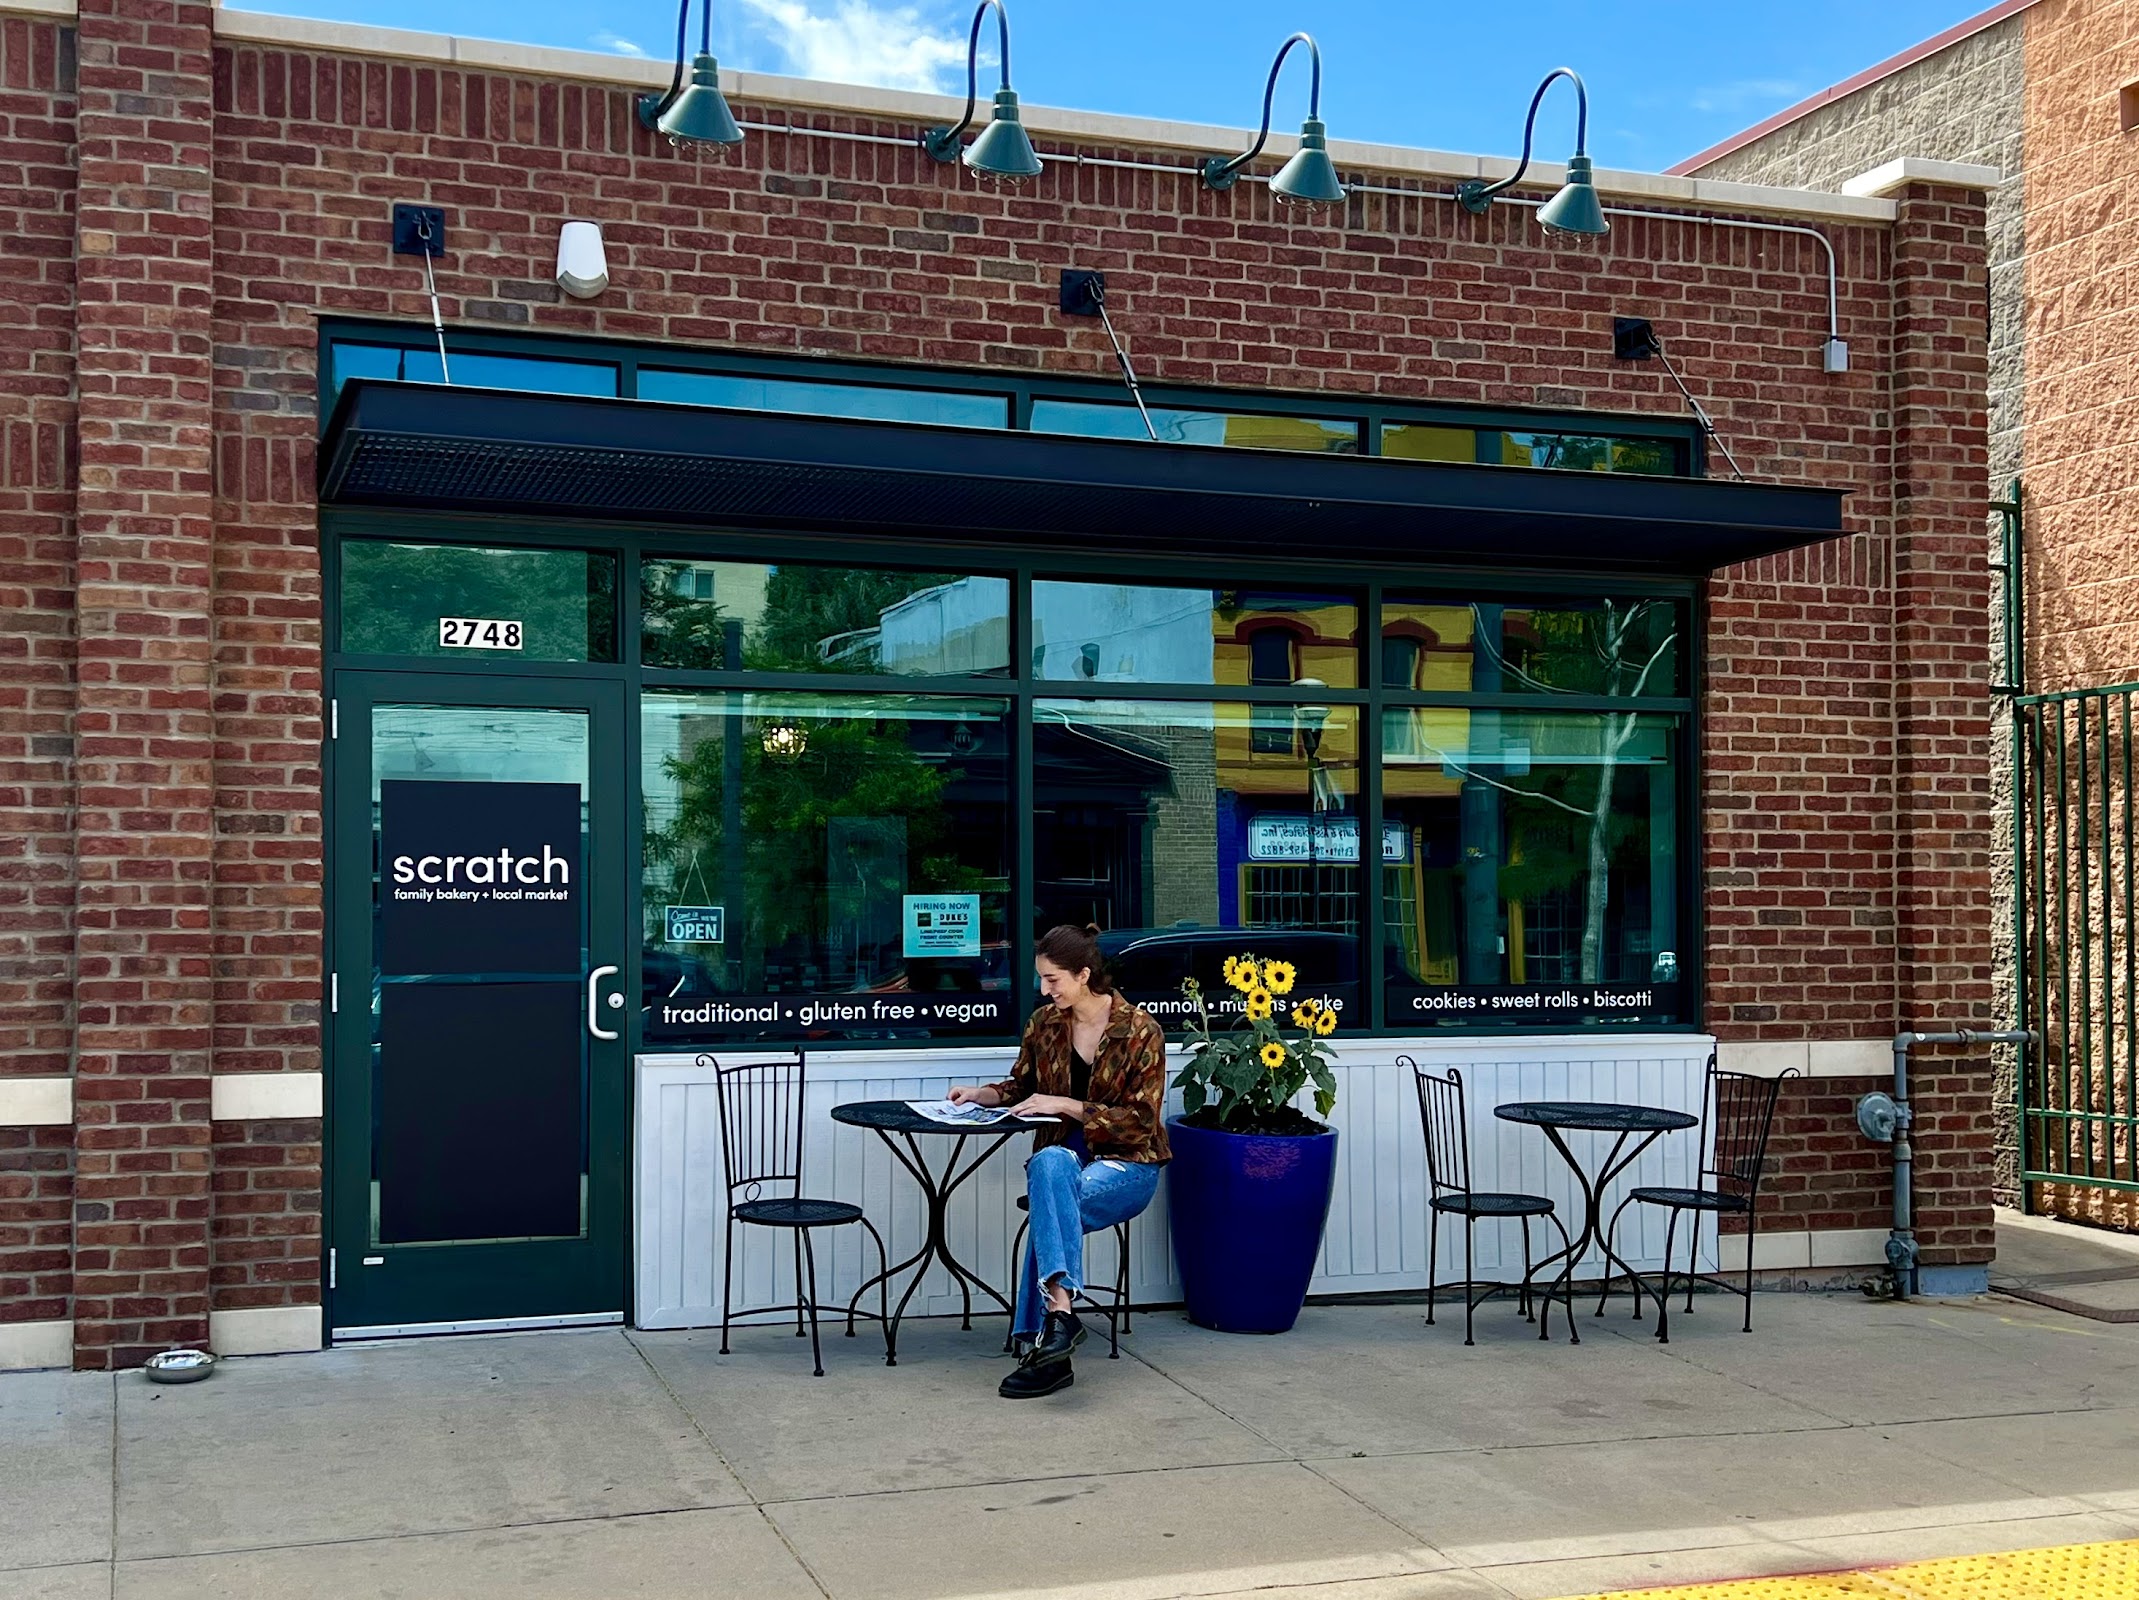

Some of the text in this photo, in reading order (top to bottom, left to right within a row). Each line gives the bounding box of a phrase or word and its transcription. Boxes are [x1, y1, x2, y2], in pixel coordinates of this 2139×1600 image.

[443, 620, 521, 647] 2748
[393, 844, 569, 884] scratch
[394, 888, 434, 902] family
[436, 888, 480, 902] bakery
[492, 888, 523, 900] local
[525, 888, 568, 900] market
[913, 902, 971, 910] HIRING NOW
[939, 913, 968, 921] DUKE'S
[671, 923, 717, 940] OPEN
[1137, 999, 1202, 1014] cannol
[1412, 990, 1652, 1009] cookies sweet rolls biscotti
[662, 1000, 997, 1026] traditional gluten free vegan
